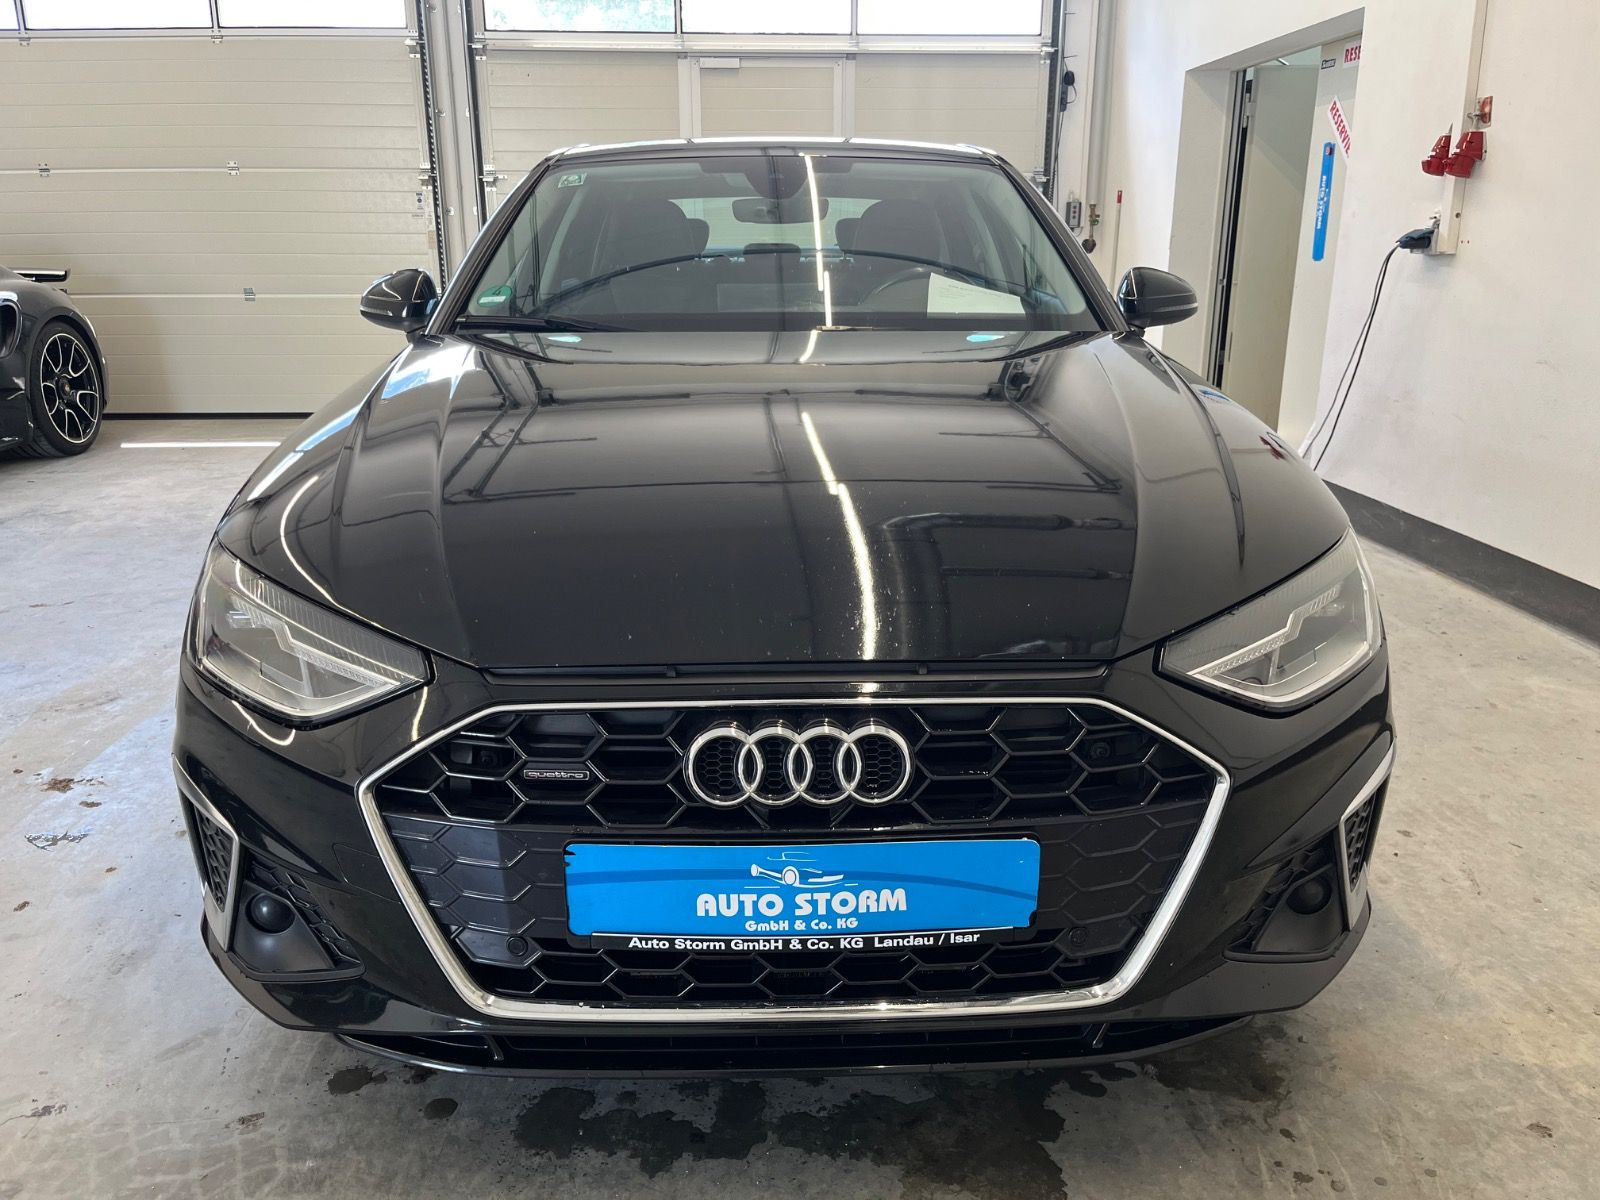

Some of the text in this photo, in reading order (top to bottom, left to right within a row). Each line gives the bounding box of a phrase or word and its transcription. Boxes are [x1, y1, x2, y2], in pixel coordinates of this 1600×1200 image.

[528, 771, 584, 779] quattro
[696, 888, 907, 917] AUTO STORM
[745, 917, 859, 932] GmbH & Co. KG
[628, 932, 981, 951] Auto Storm GmbH & Co. KG Landau / Isar
